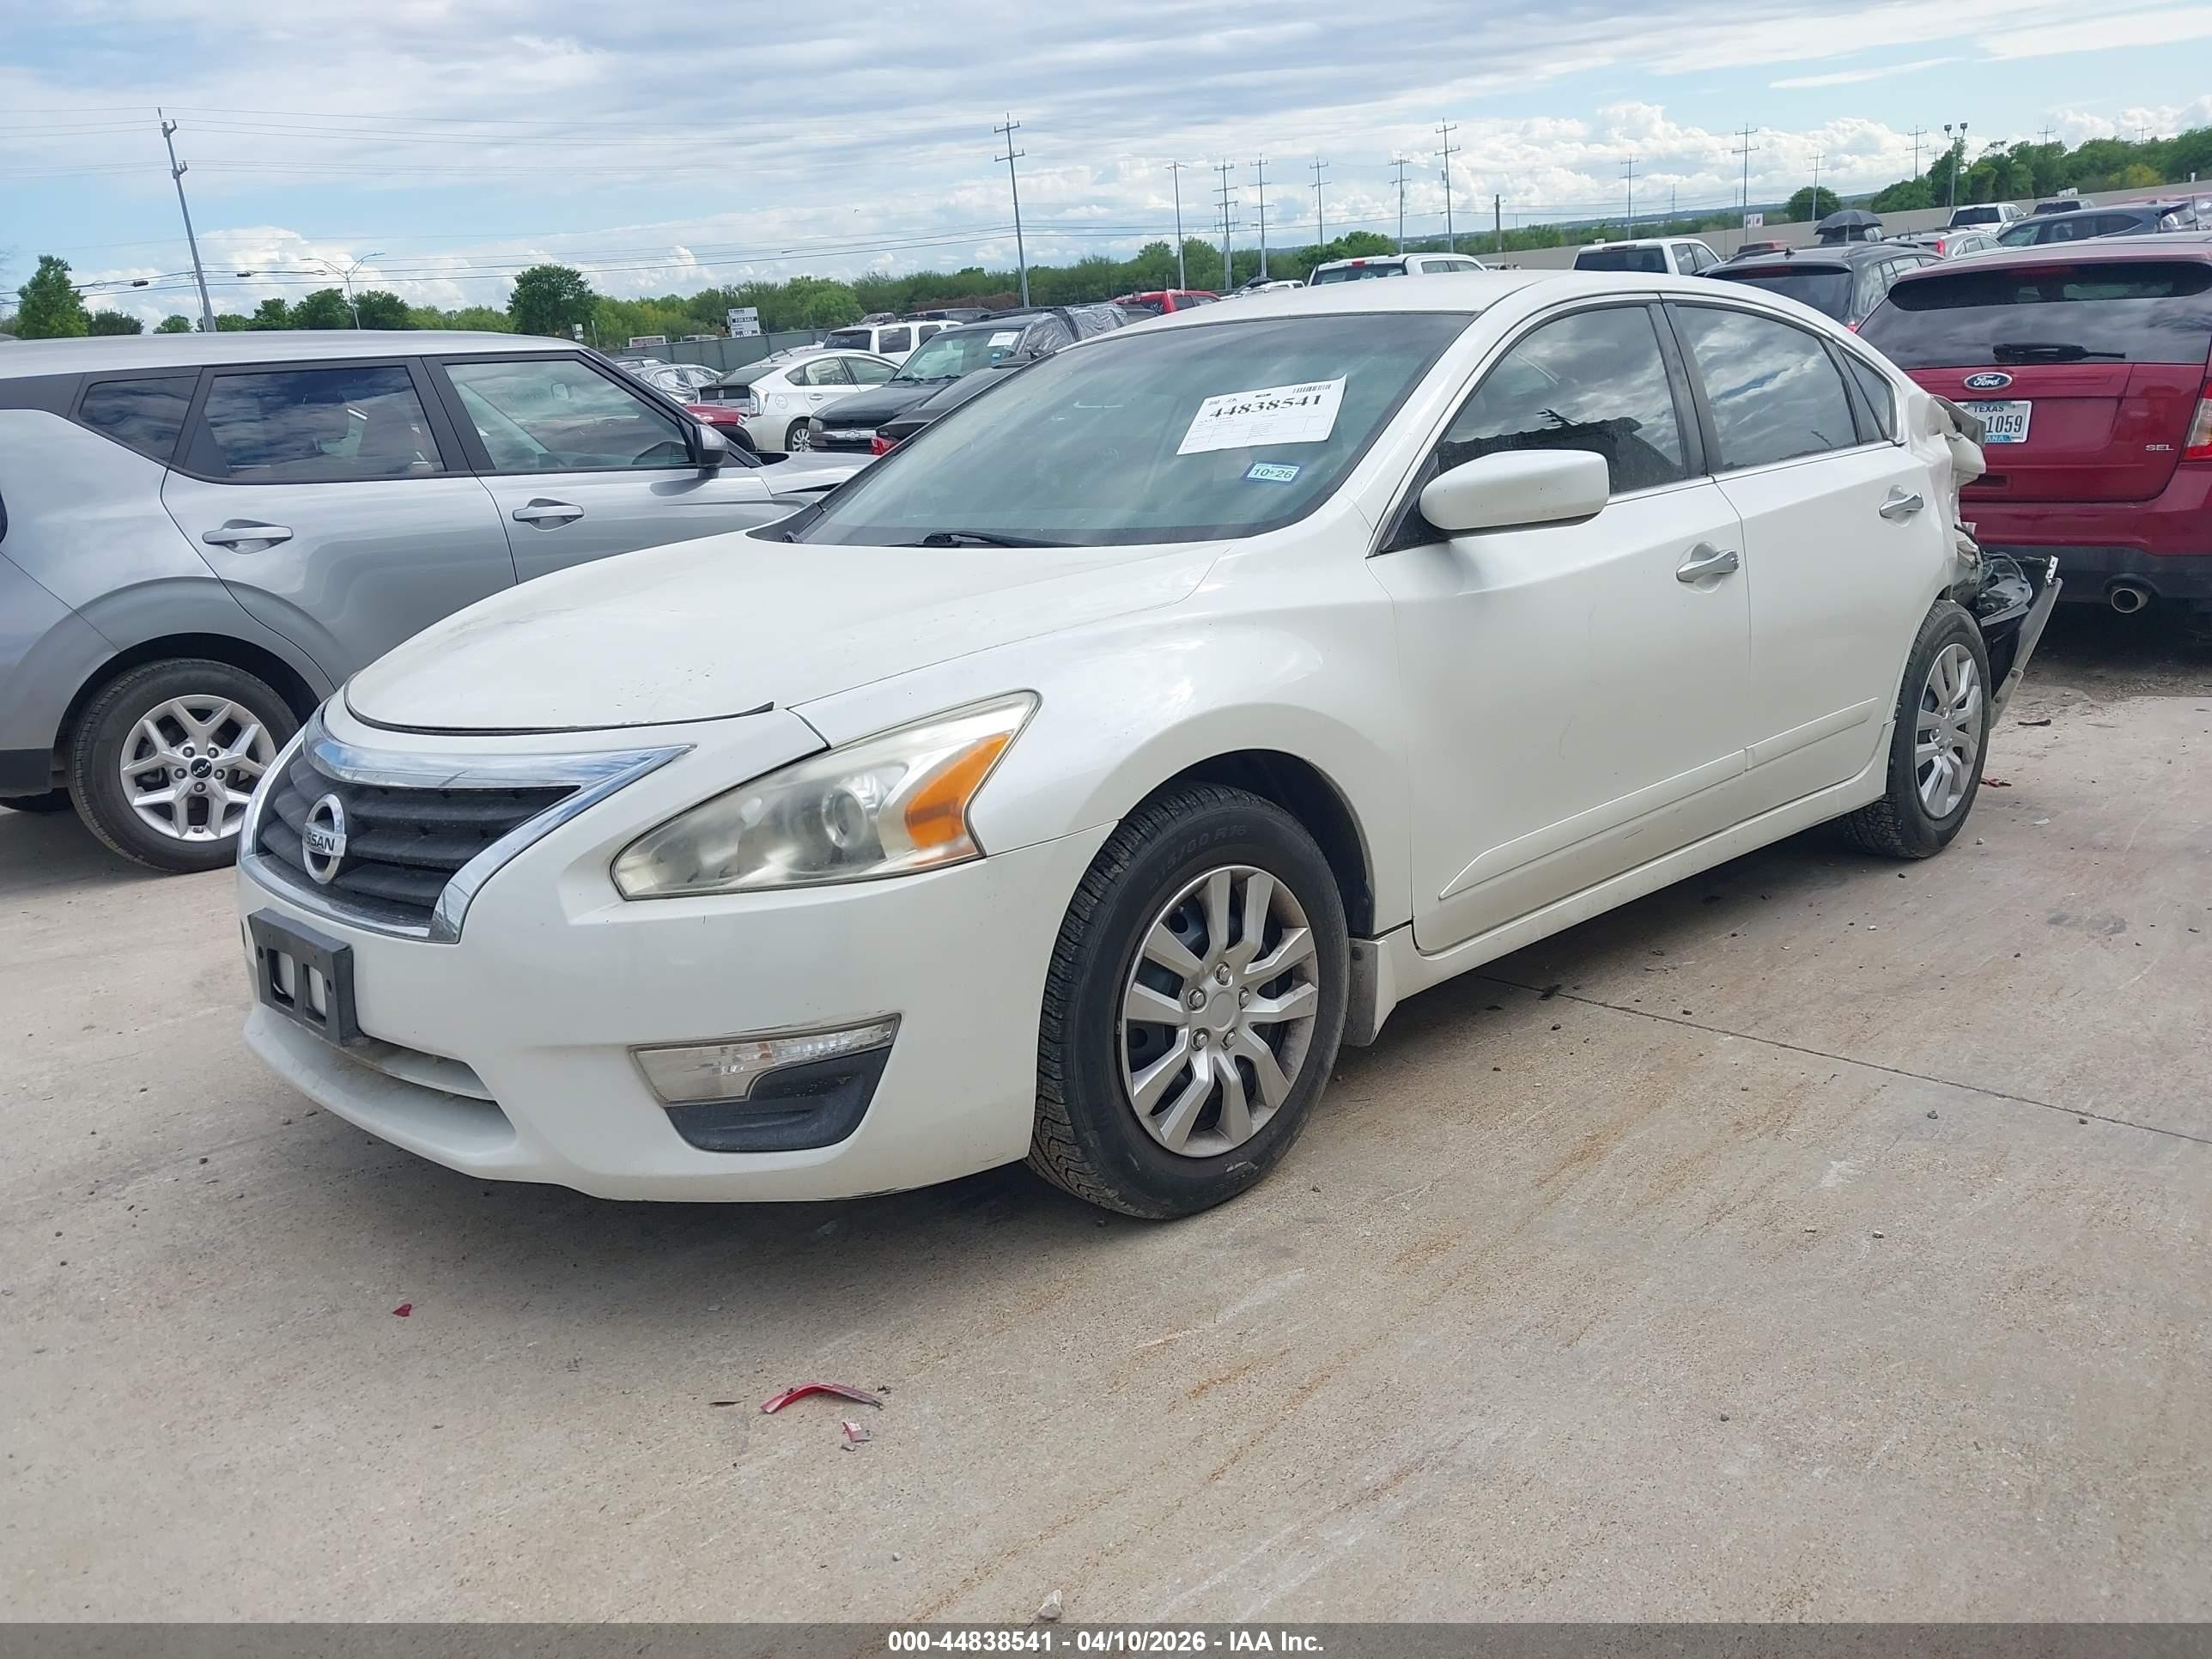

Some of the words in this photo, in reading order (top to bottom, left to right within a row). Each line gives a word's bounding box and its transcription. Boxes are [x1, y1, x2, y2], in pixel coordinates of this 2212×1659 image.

[1973, 374, 2001, 386] Ford
[1209, 394, 1322, 418] 44838541
[1985, 415, 2023, 433] 1059
